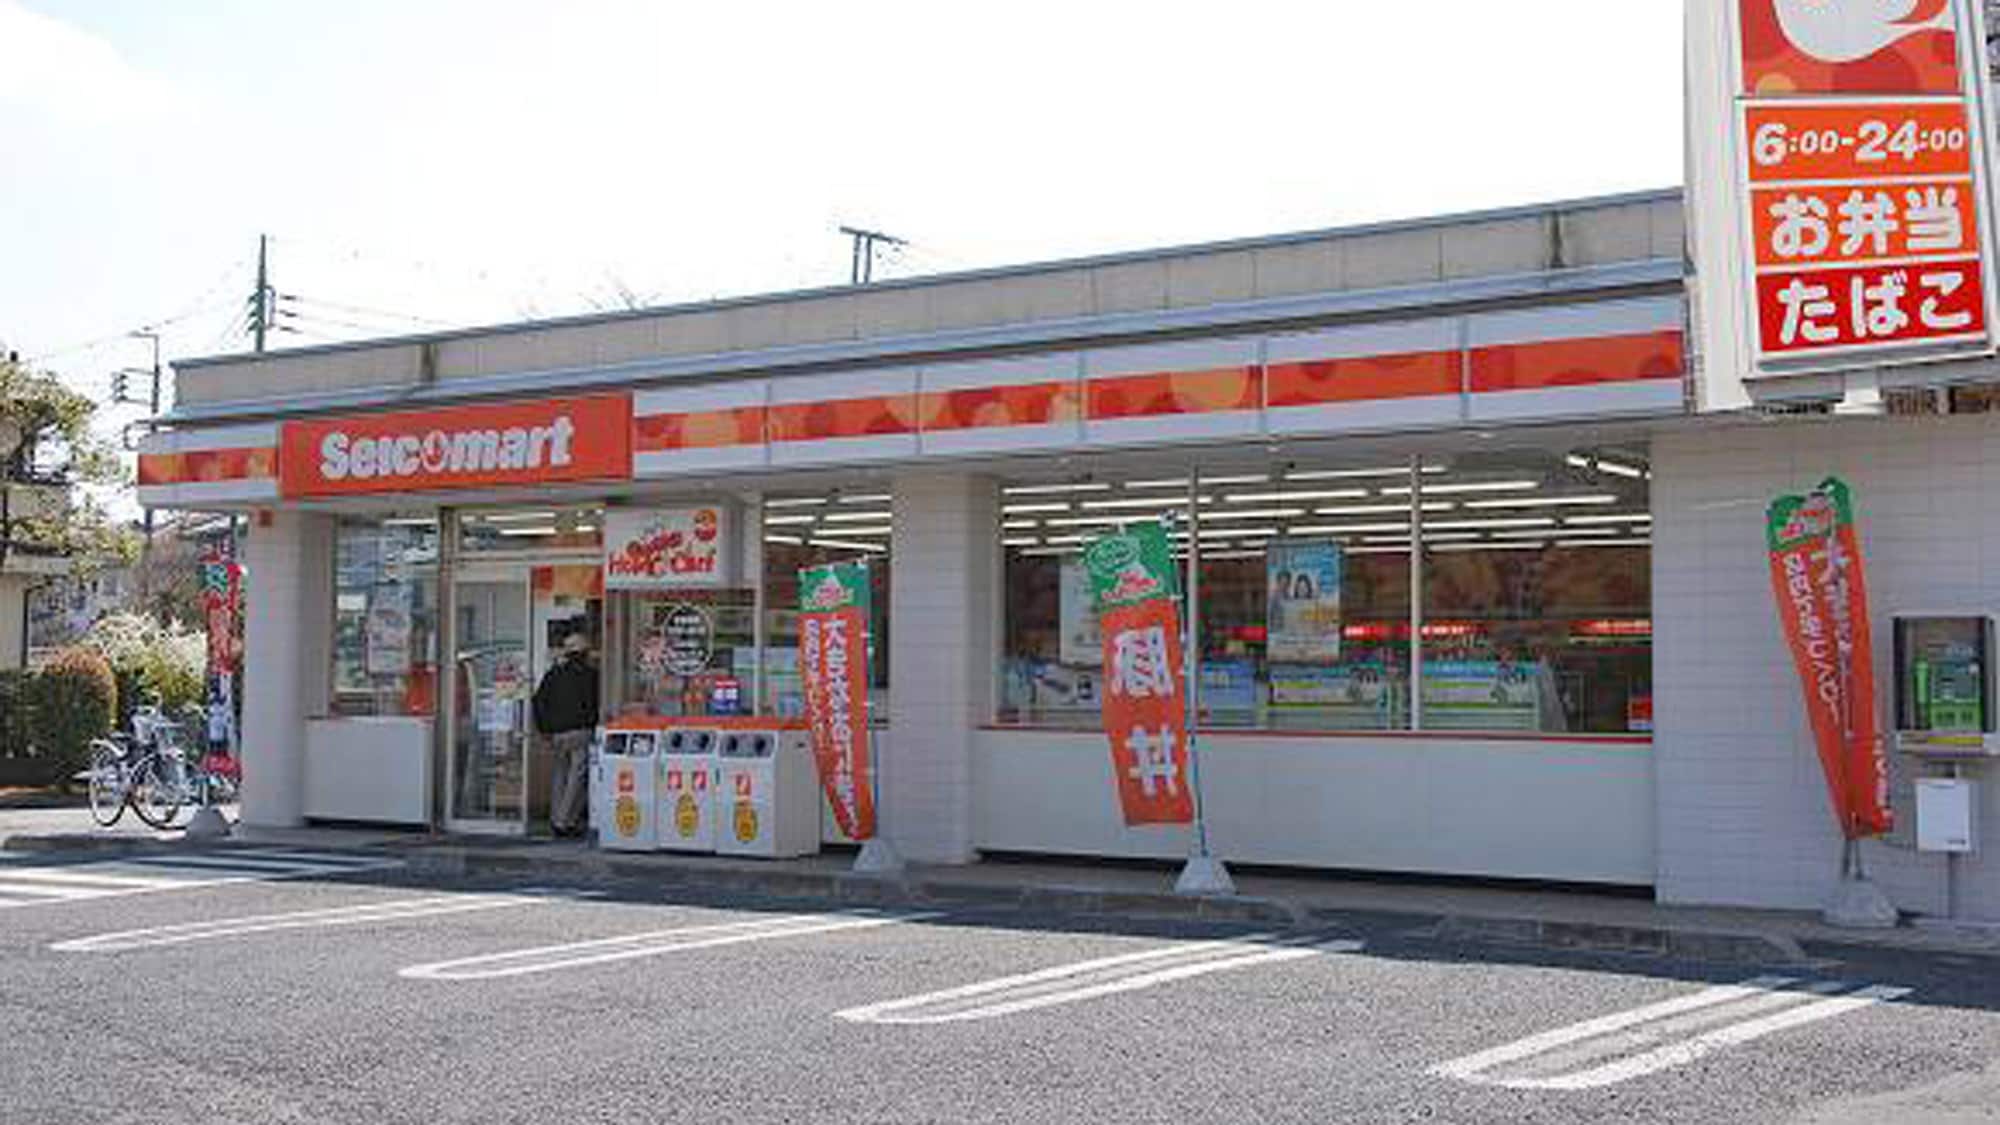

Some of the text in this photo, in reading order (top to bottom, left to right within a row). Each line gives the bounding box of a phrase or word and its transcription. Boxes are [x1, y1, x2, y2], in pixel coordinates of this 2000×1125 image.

[1753, 120, 1964, 166] 6:00-24:00
[1769, 186, 1964, 256] お弁当
[1776, 271, 1972, 345] たばこ
[320, 416, 574, 480] Seicomart
